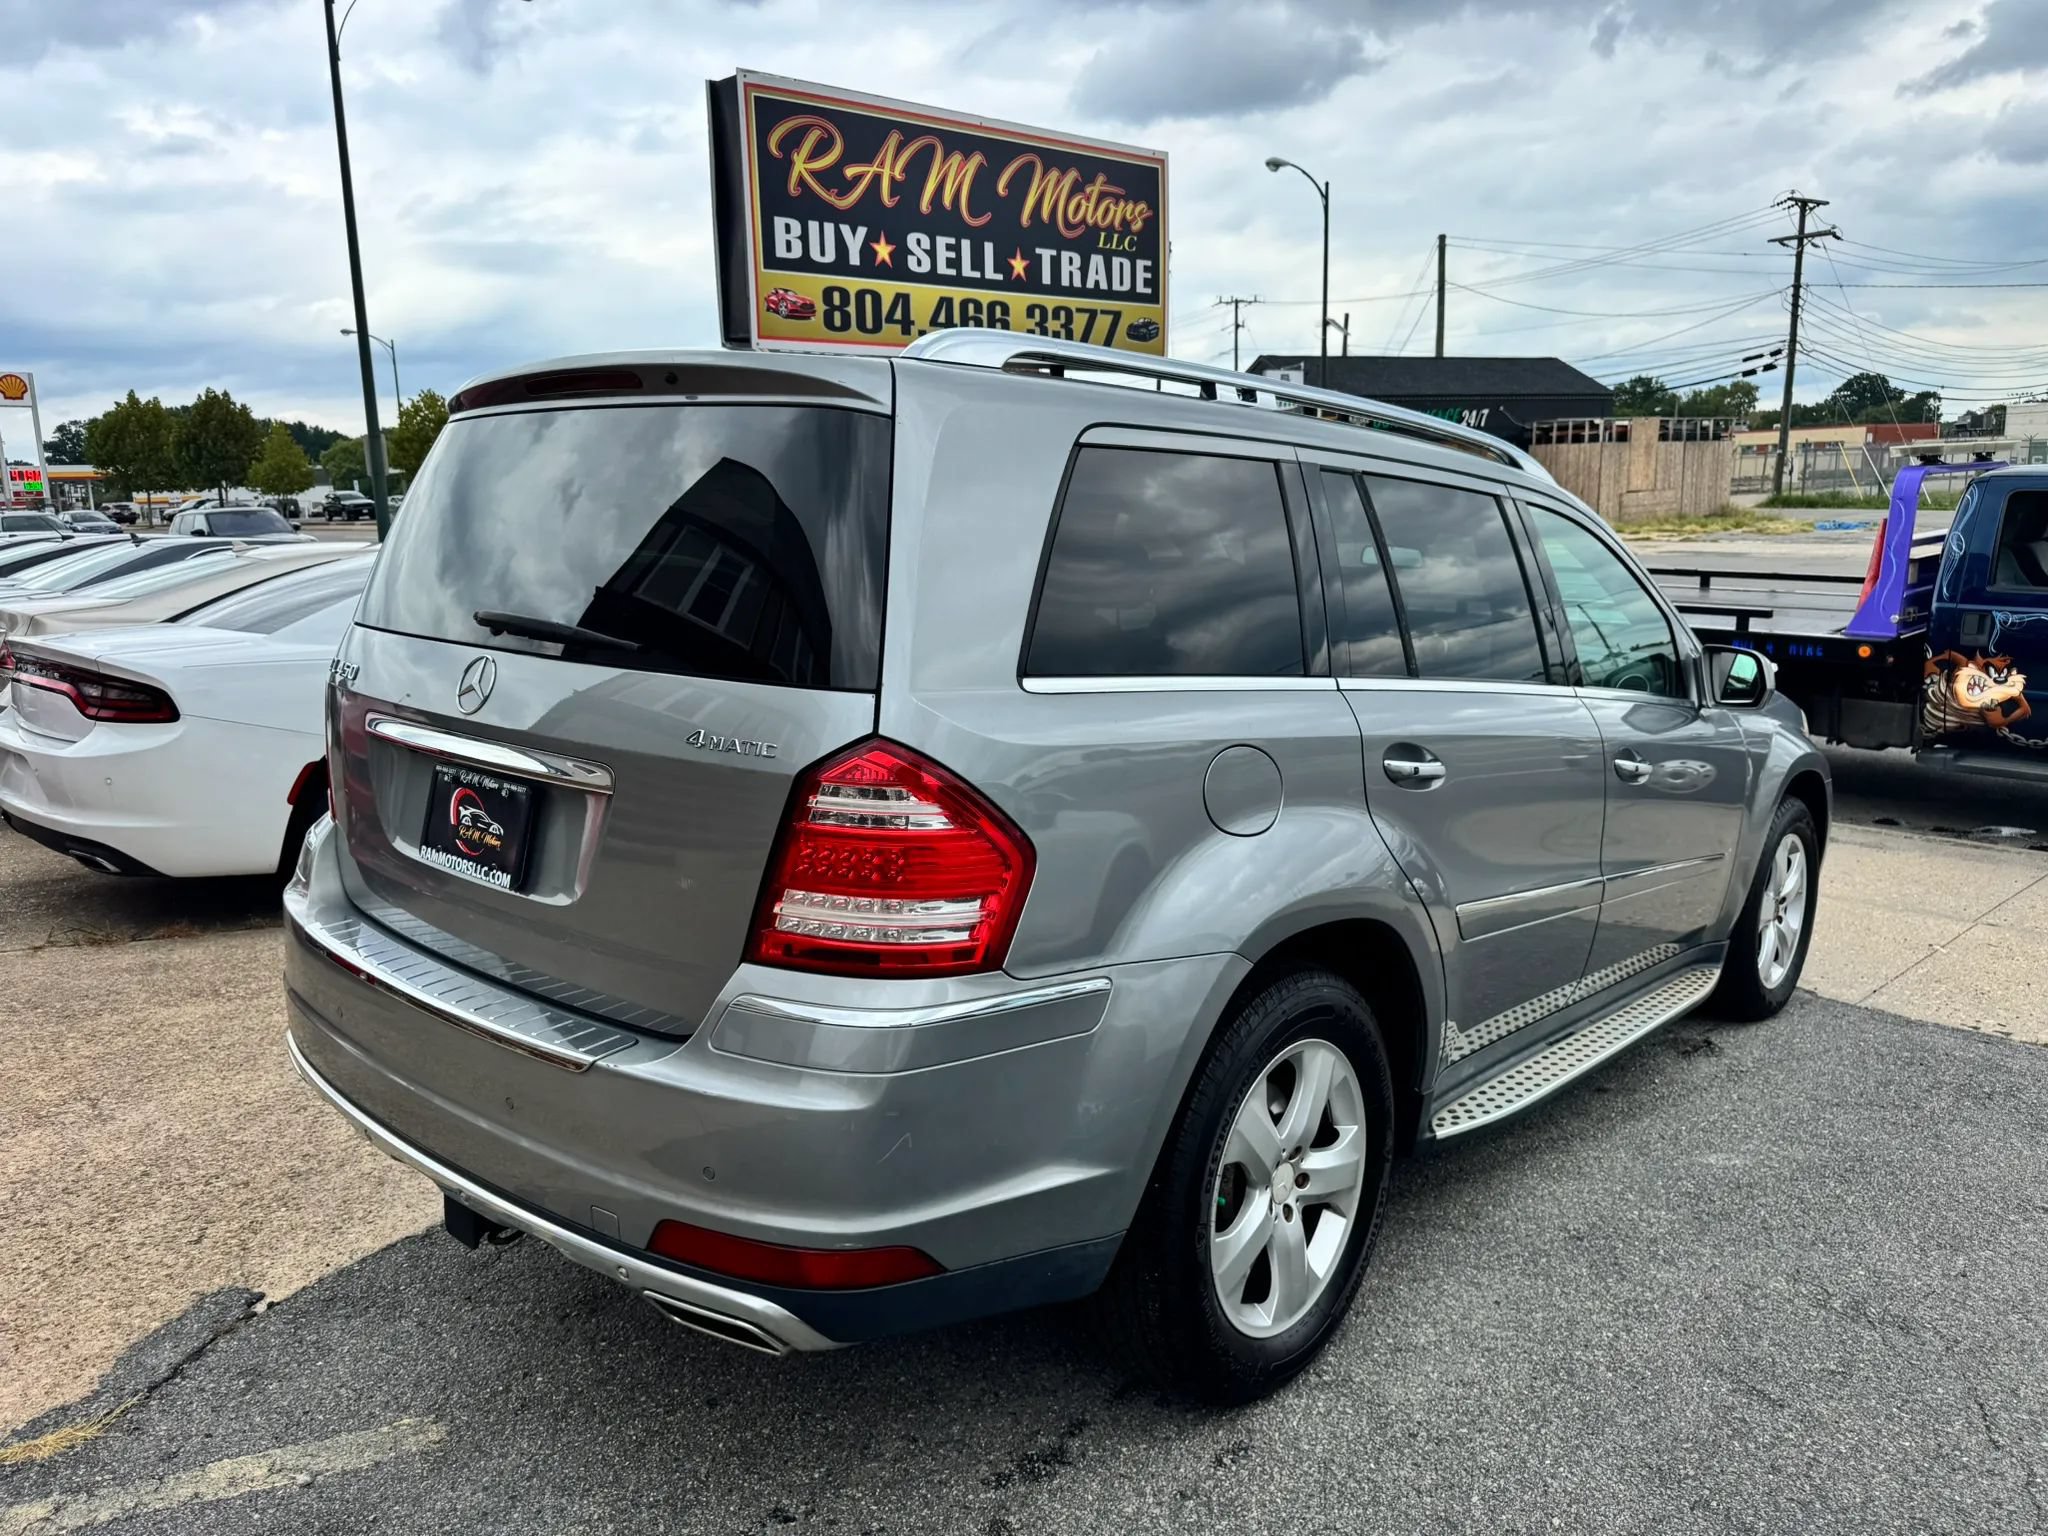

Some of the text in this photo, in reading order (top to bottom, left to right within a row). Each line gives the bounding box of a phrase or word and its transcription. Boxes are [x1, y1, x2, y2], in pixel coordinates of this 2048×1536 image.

[767, 115, 1153, 239] RAM Motors
[773, 216, 1152, 294] BUY SELL TRADE
[1098, 231, 1137, 252] LLC
[822, 286, 1122, 346] 804.4663377
[1461, 408, 1490, 428] 24/7
